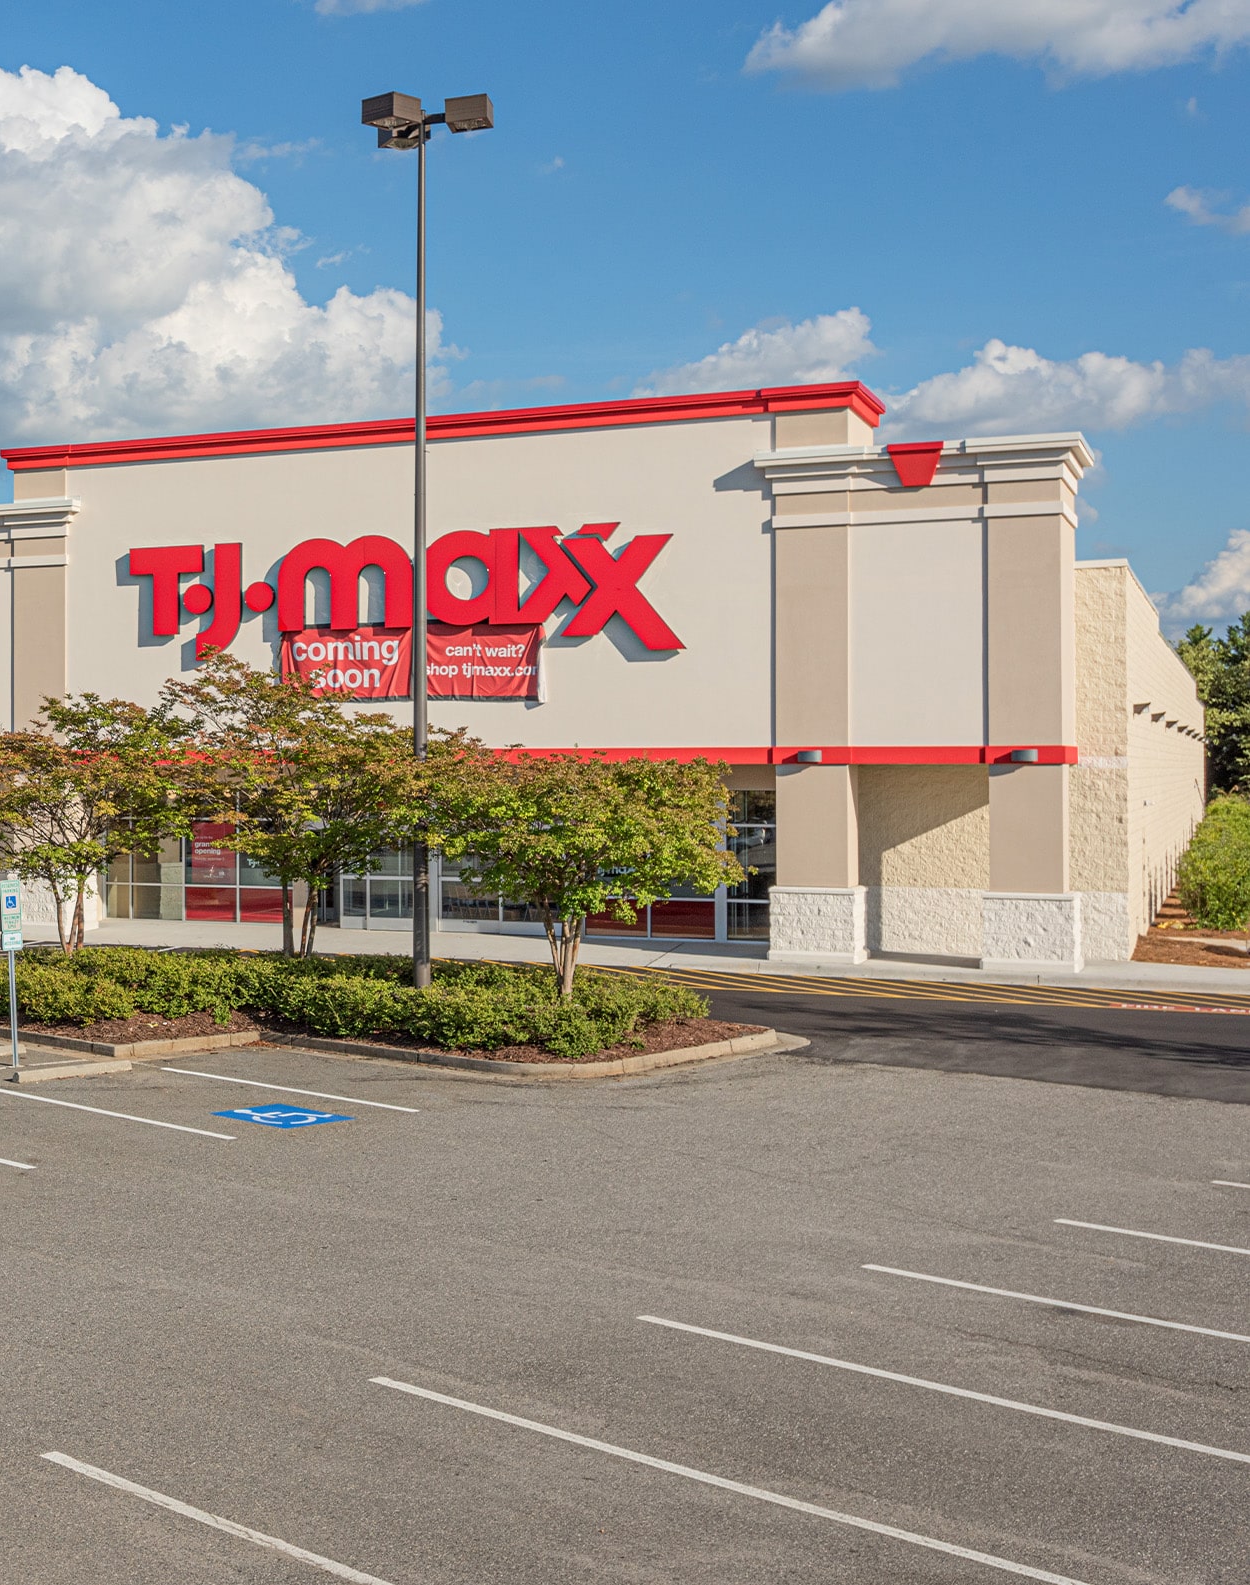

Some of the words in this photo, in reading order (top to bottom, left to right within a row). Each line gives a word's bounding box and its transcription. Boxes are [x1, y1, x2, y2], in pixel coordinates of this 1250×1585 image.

[293, 636, 400, 665] coming
[445, 643, 482, 657] can't
[485, 643, 526, 657] wait?
[310, 668, 381, 689] soon
